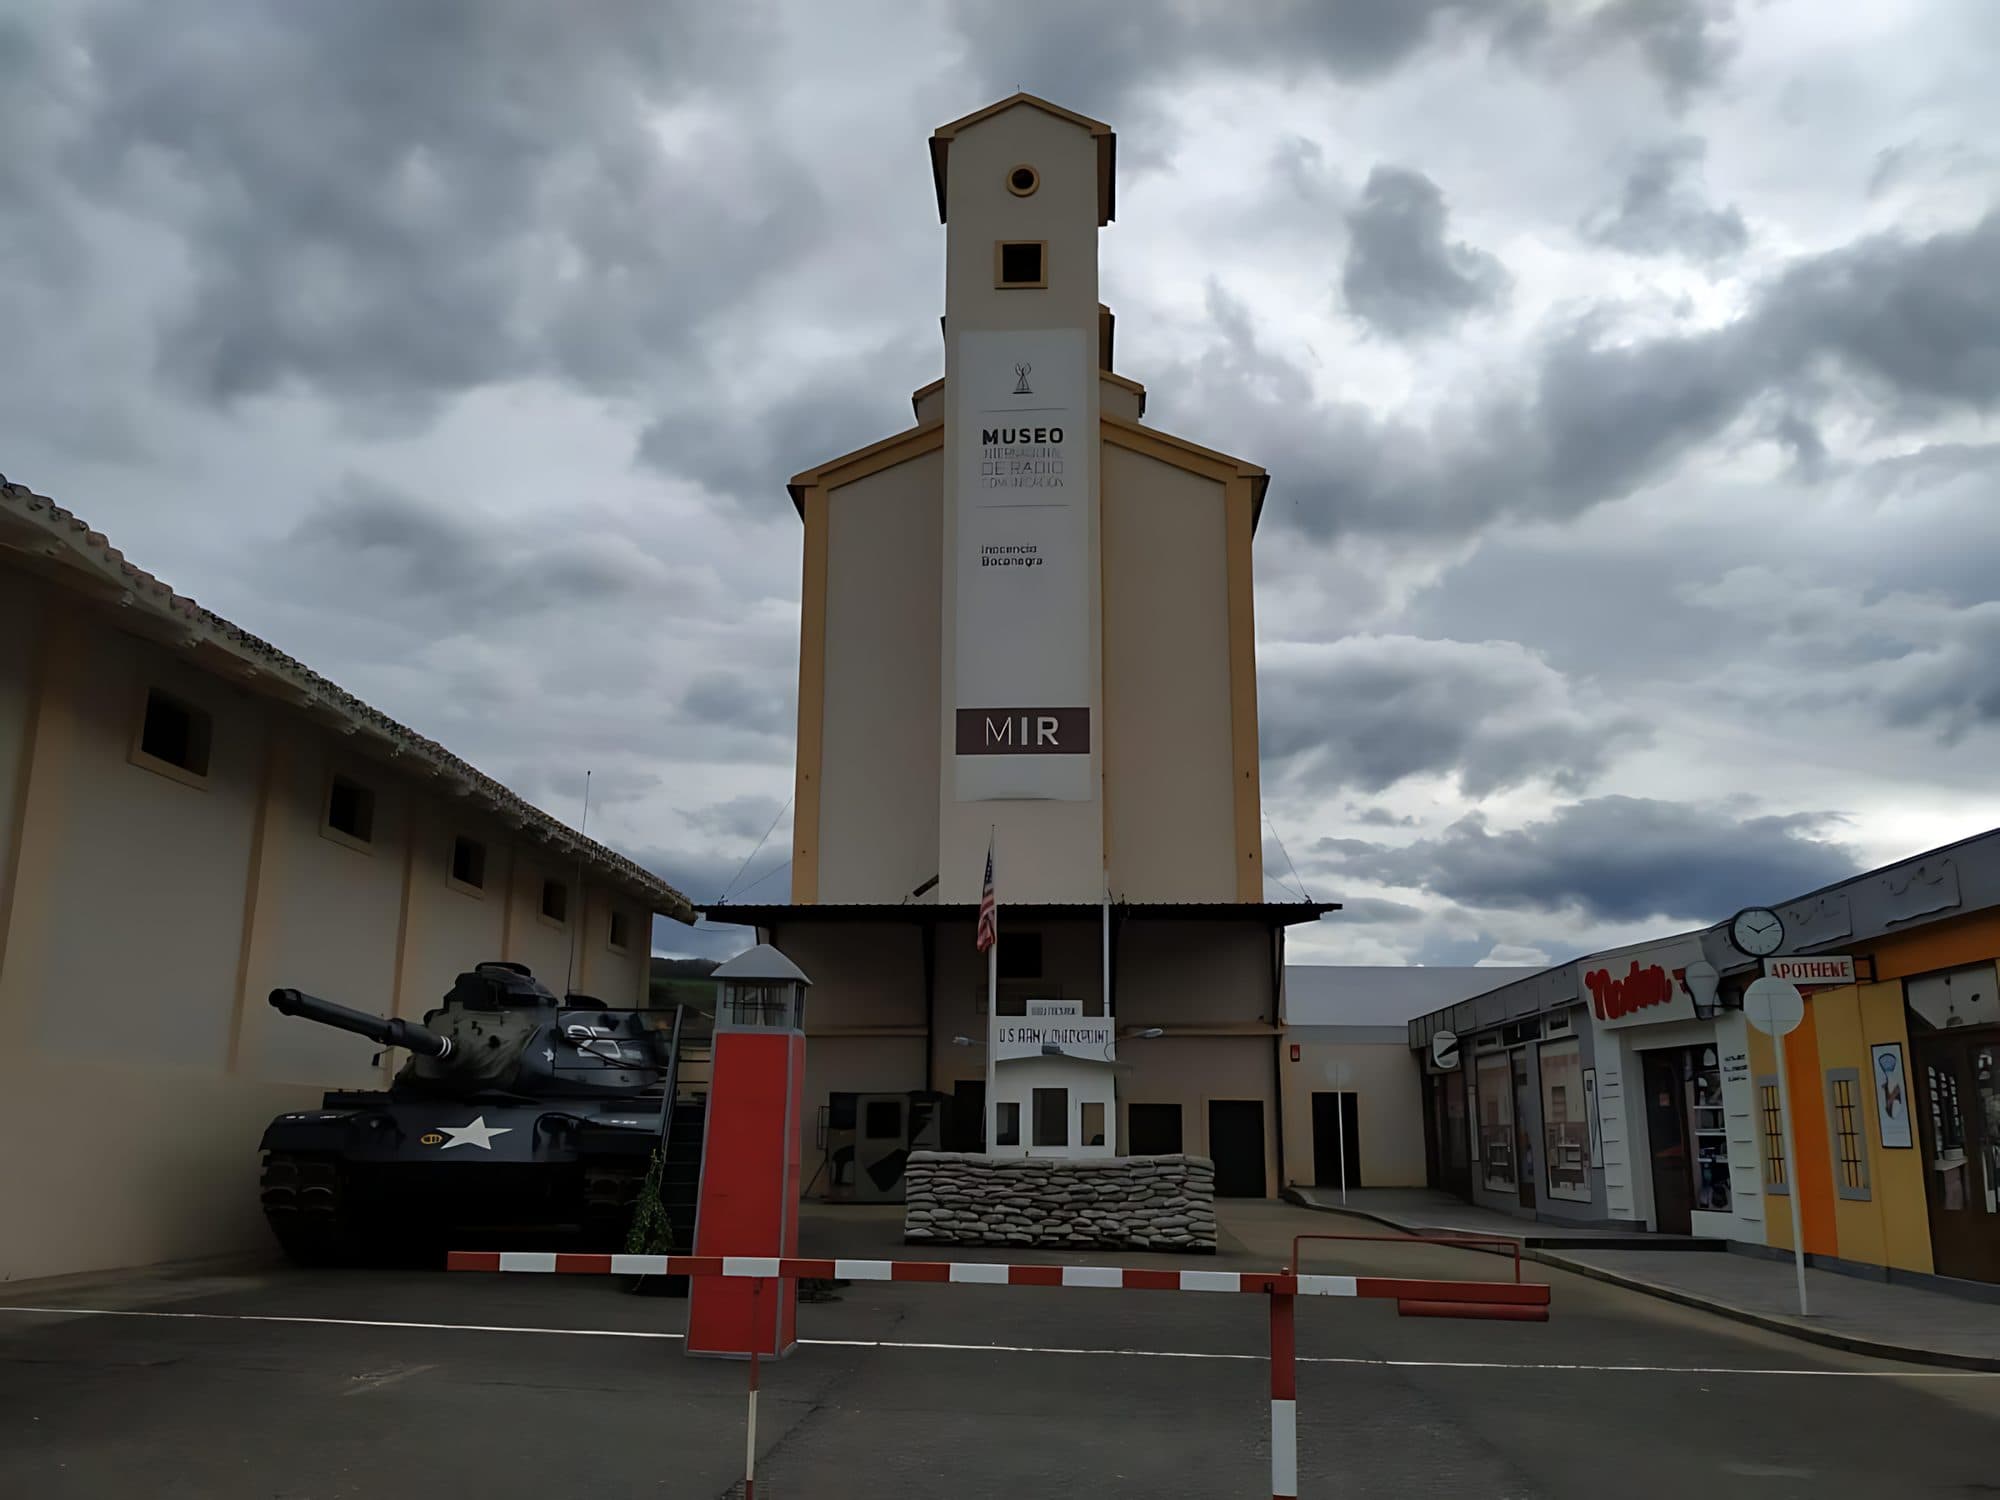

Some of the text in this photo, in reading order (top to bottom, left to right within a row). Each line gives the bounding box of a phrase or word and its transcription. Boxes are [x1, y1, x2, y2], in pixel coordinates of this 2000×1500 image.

[982, 427, 1064, 445] MUSEO
[1010, 460, 1064, 475] RADIO
[985, 716, 1059, 746] MIR
[1771, 961, 1849, 979] APOTHEKE
